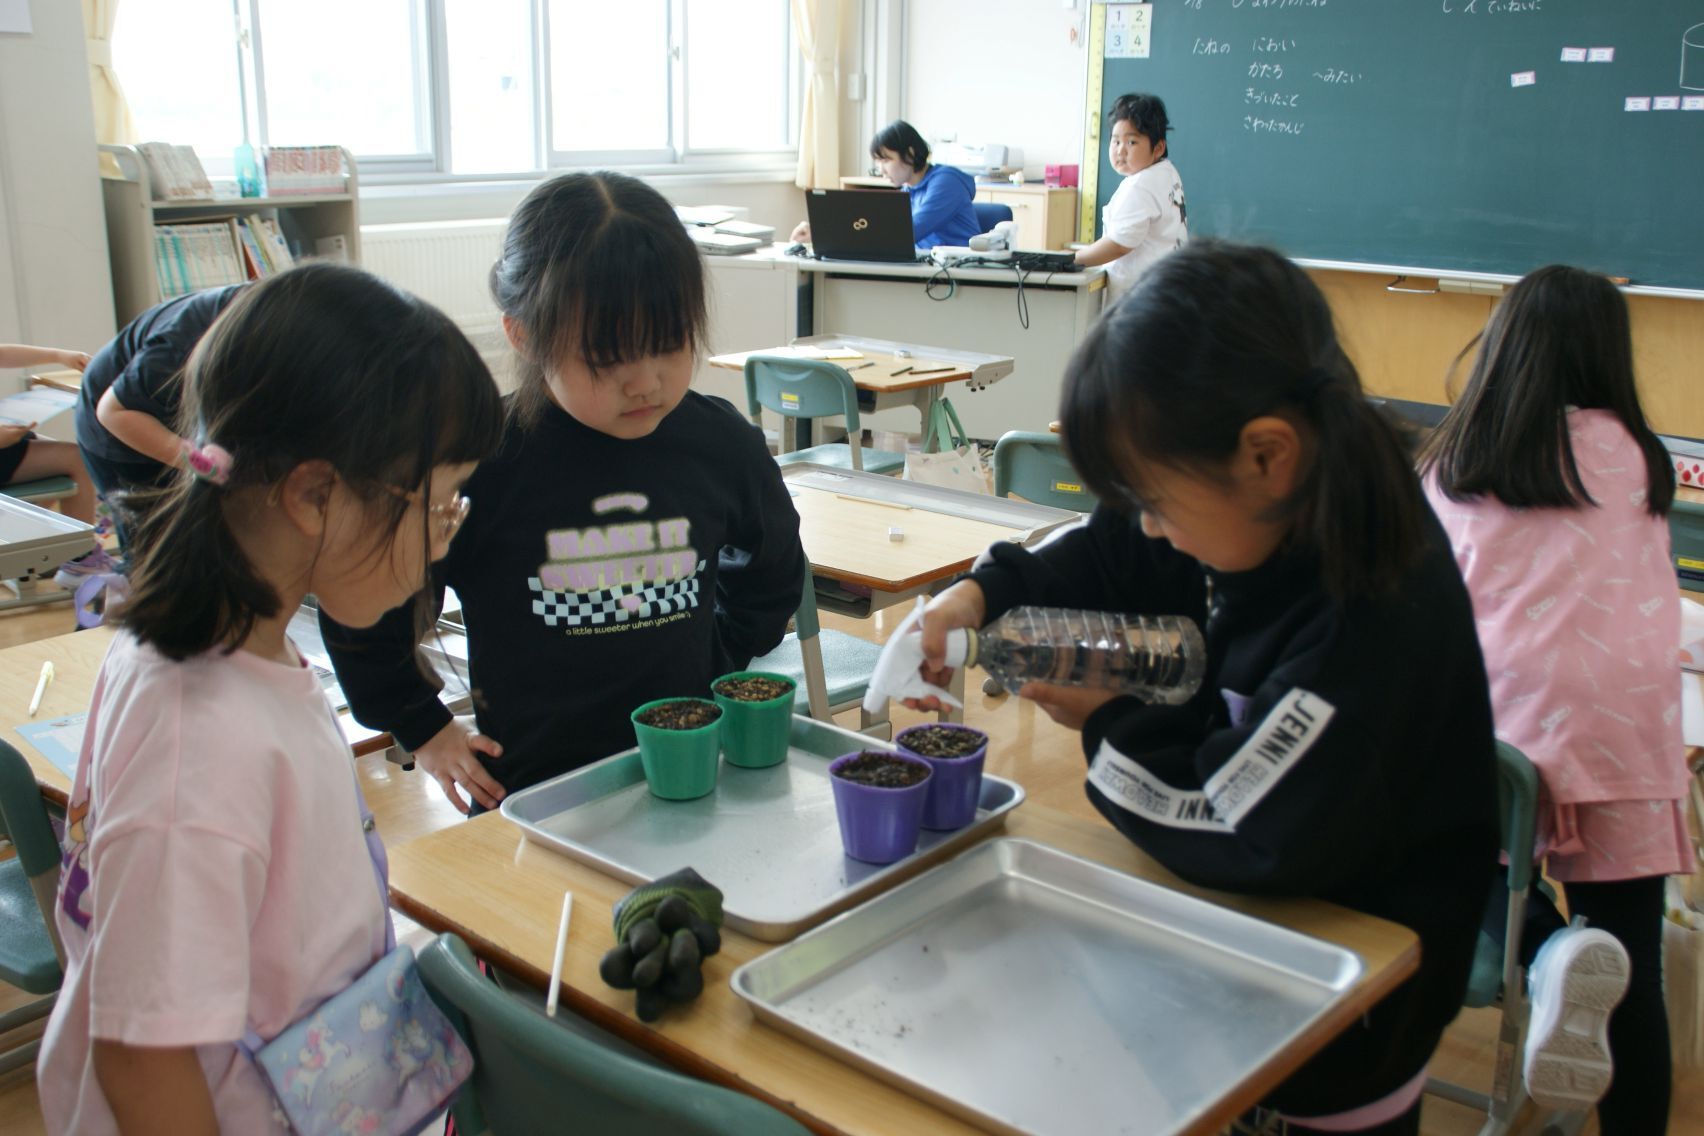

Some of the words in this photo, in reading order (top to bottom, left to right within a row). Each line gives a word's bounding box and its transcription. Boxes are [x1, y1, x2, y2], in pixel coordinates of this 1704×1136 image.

[1116, 10, 1121, 22] 1
[1136, 10, 1143, 22] 2
[1113, 35, 1121, 47] 3
[1134, 35, 1141, 47] 4
[1193, 37, 1231, 56] たねの
[1252, 37, 1296, 52] におい
[1244, 87, 1300, 108] きづいたこと
[546, 522, 655, 560] MAKE
[658, 517, 690, 548] IT
[572, 626, 593, 636] little
[594, 623, 630, 635] sweeter
[632, 619, 654, 630] when
[654, 615, 669, 628] you
[1255, 700, 1315, 765] JENNI
